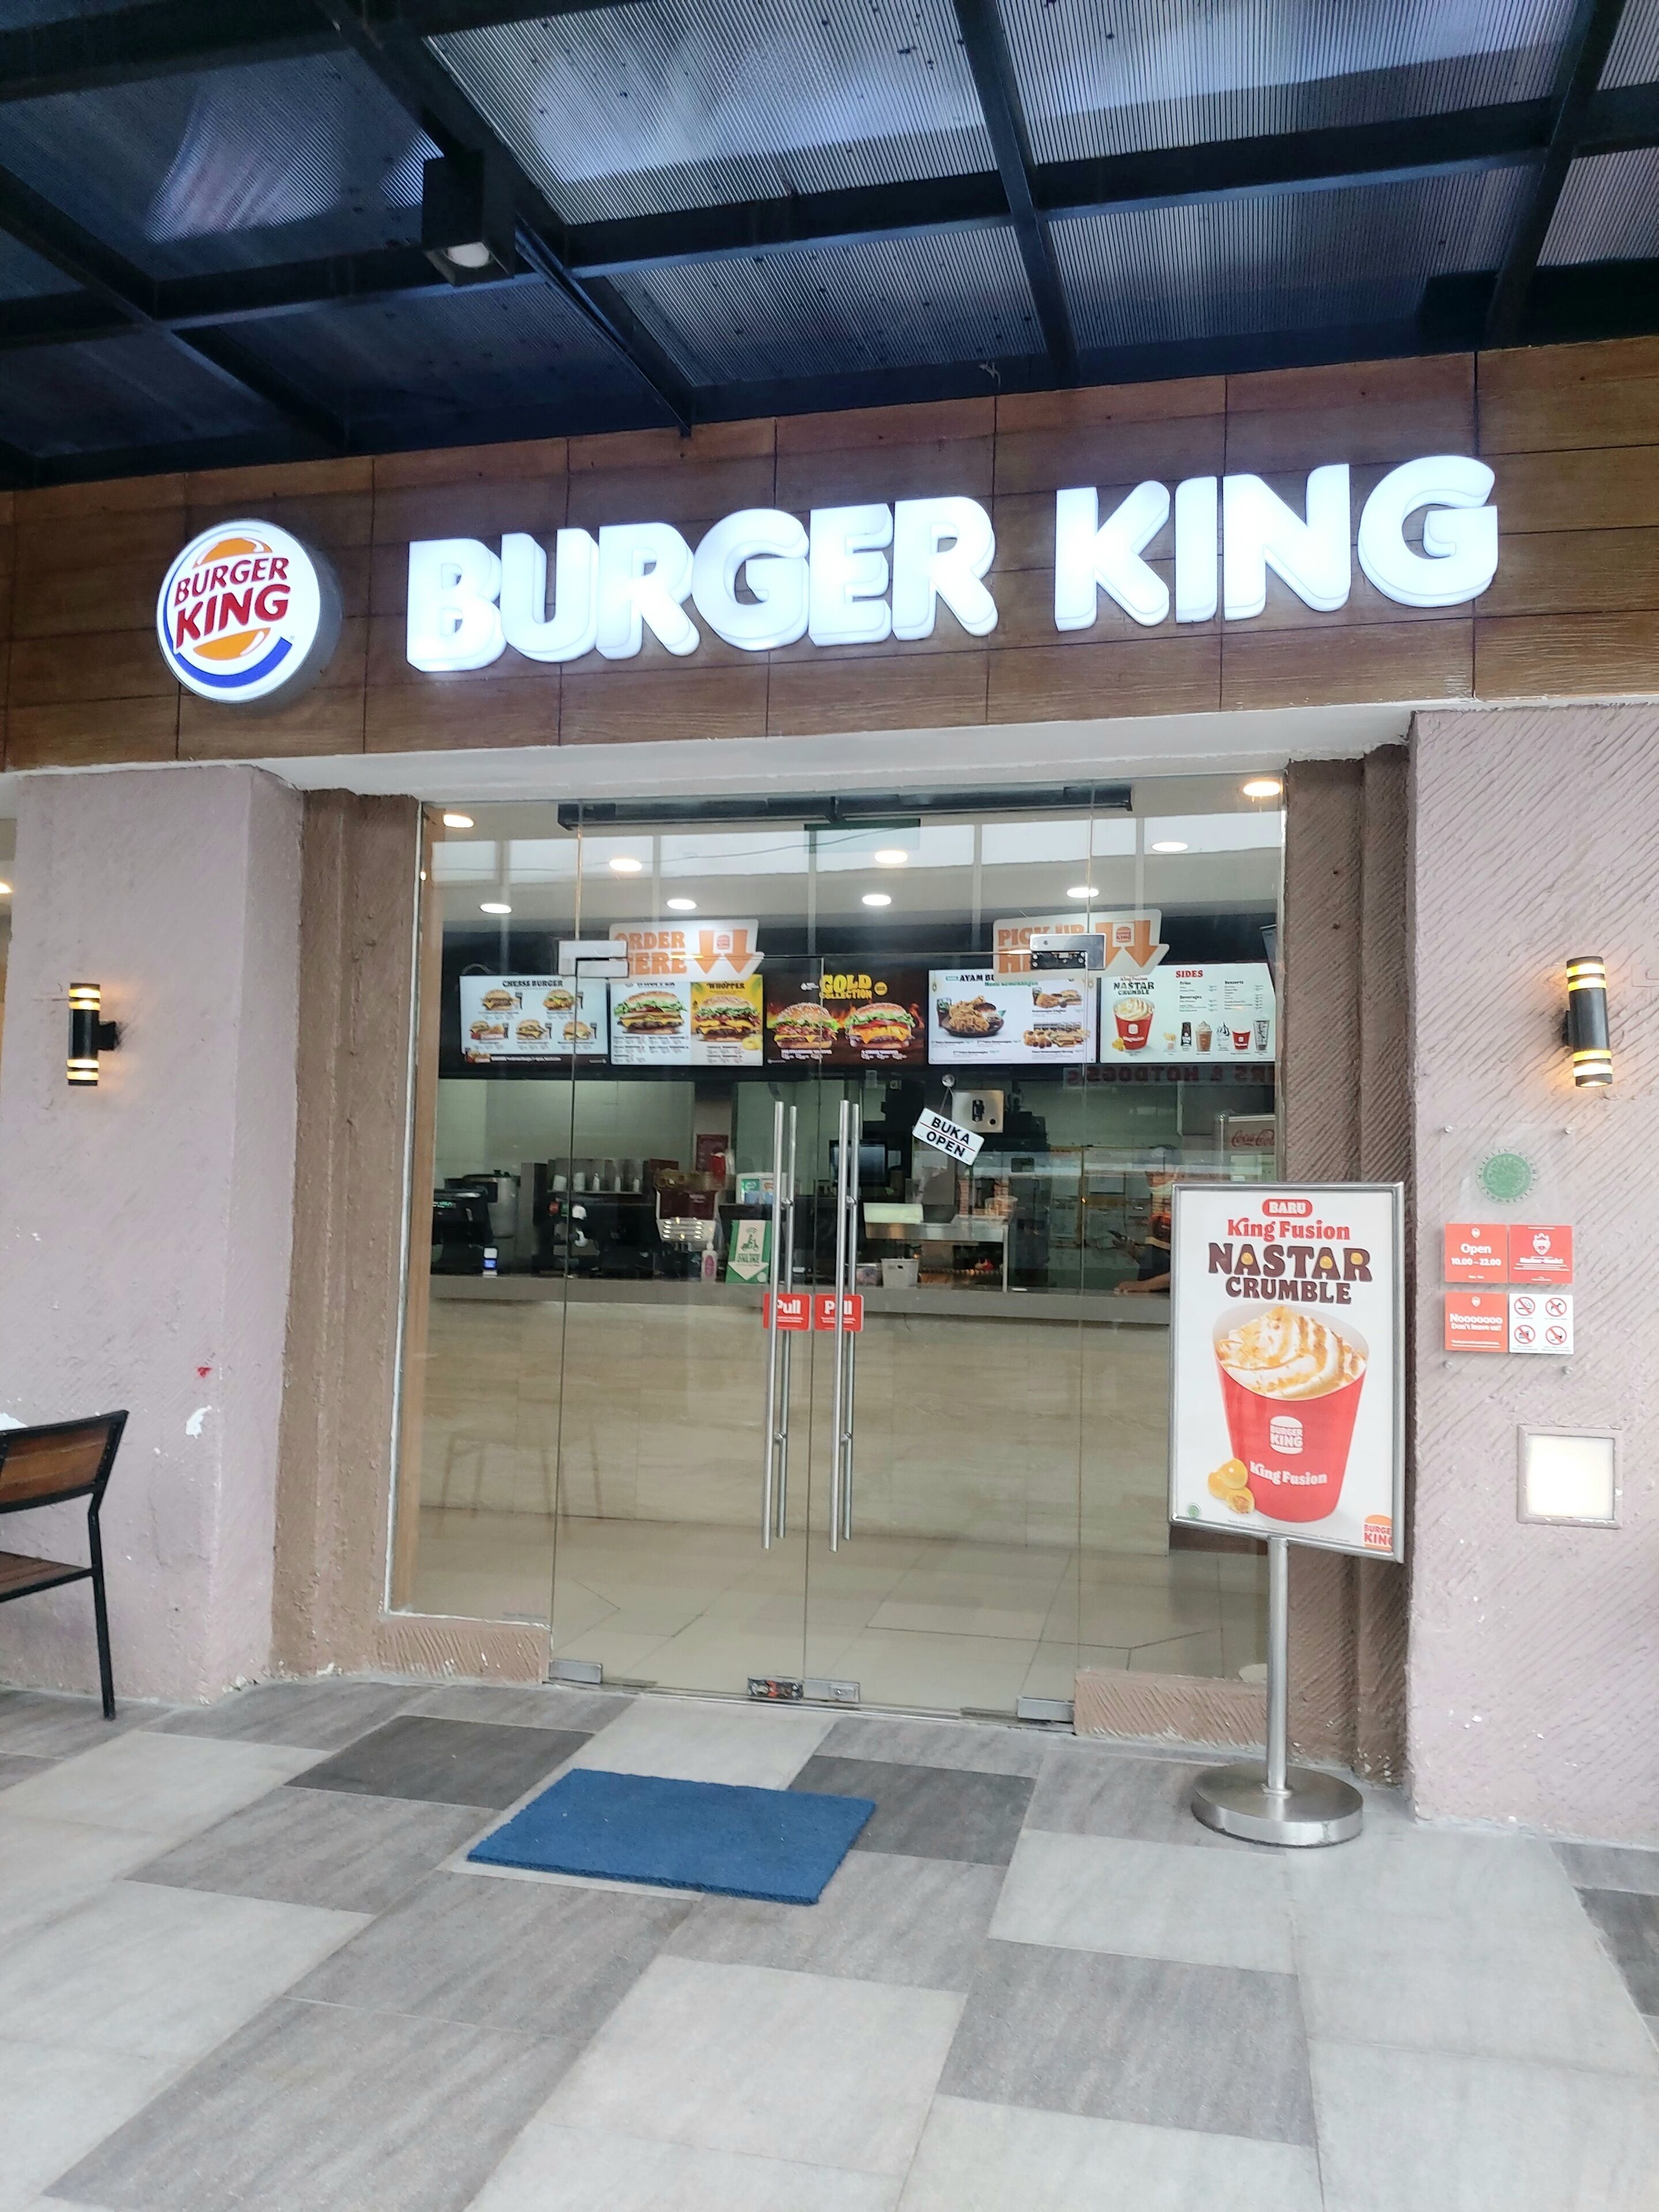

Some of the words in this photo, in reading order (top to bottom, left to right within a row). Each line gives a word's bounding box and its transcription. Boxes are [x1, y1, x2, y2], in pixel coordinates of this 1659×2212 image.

[407, 496, 998, 672] BURGER
[1054, 455, 1498, 632] KING
[175, 558, 289, 606] BURGER
[176, 584, 290, 648] KING
[628, 952, 687, 974] ERE
[820, 974, 872, 993] GOLD
[1113, 981, 1154, 990] NASTAR
[931, 1116, 970, 1145] BUKA
[926, 1131, 965, 1157] OPEN
[1268, 1202, 1306, 1214] BARU
[1228, 1217, 1276, 1243] King
[1279, 1219, 1350, 1240] Fusion
[1460, 1243, 1492, 1256] Open
[1209, 1243, 1373, 1282] NASTAR
[1225, 1277, 1352, 1304] CRUMBLE
[824, 1300, 853, 1315] Pll
[1270, 1426, 1303, 1437] BURGER
[1270, 1433, 1303, 1448] KING
[1249, 1460, 1281, 1486] King
[1282, 1470, 1328, 1486] Fusion
[1364, 1524, 1392, 1535] BURGE
